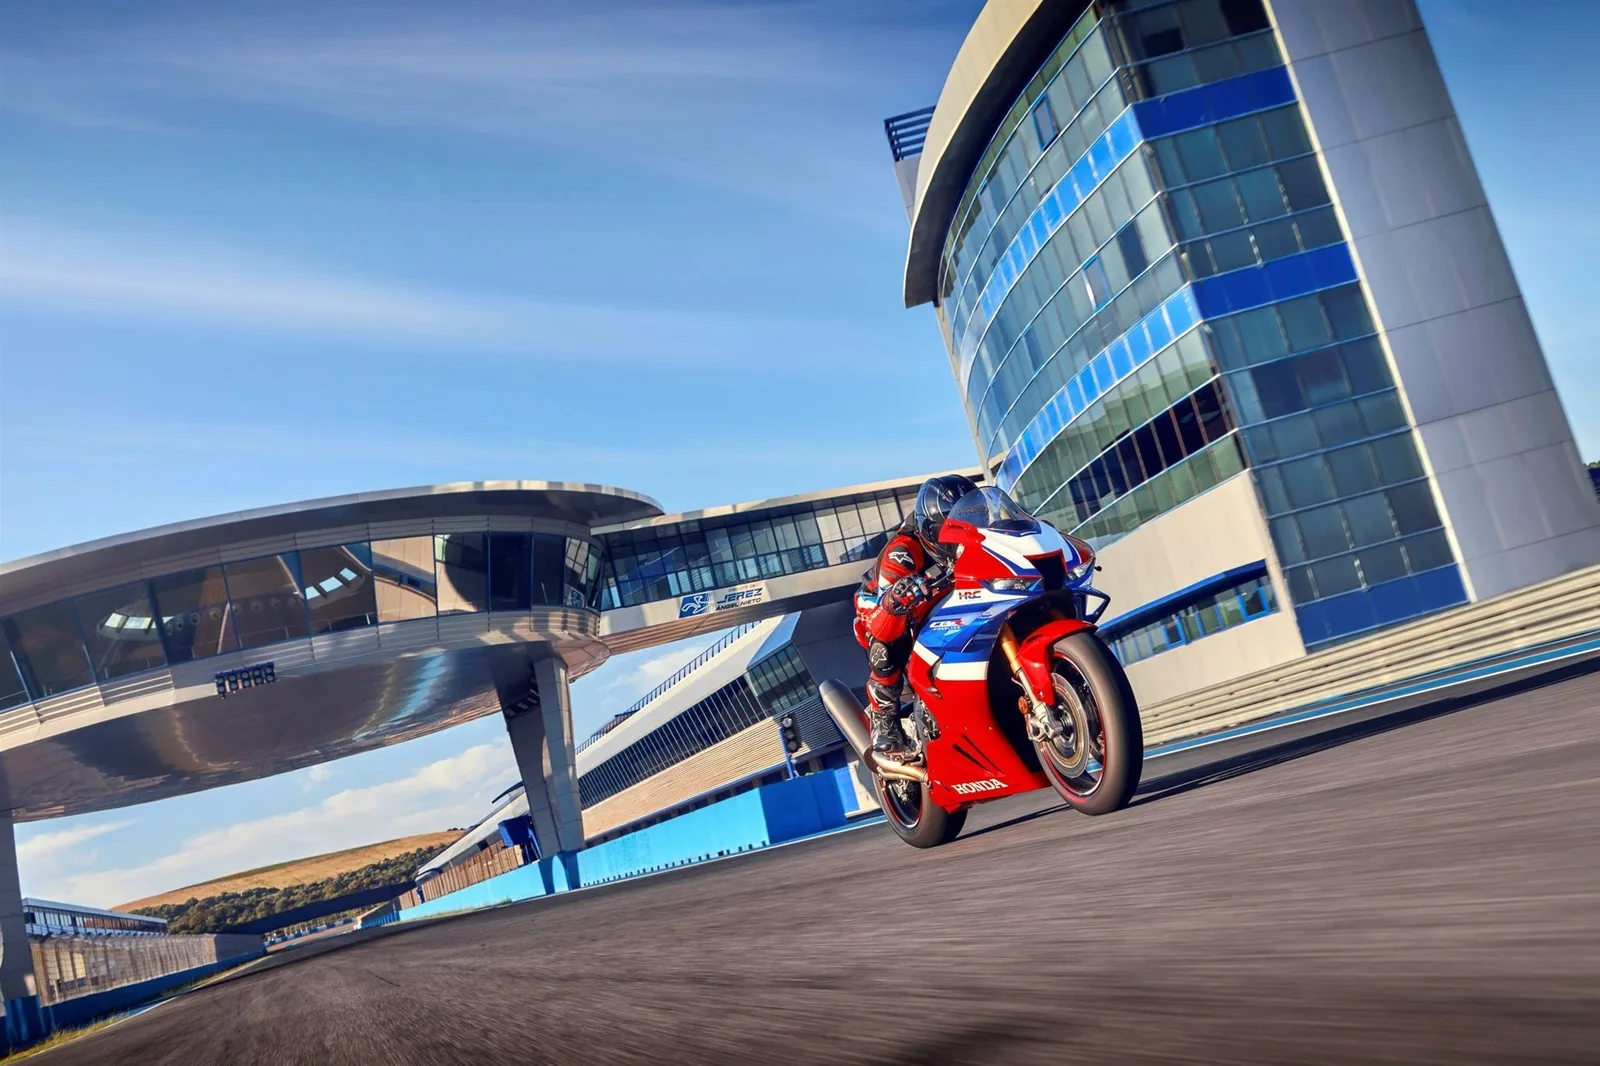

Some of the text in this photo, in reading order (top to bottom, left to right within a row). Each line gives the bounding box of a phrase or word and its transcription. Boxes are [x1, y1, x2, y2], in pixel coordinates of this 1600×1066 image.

[717, 588, 763, 604] JEREZ
[740, 597, 762, 606] NIETO
[958, 590, 981, 600] HRC
[951, 778, 1009, 794] HONDA
